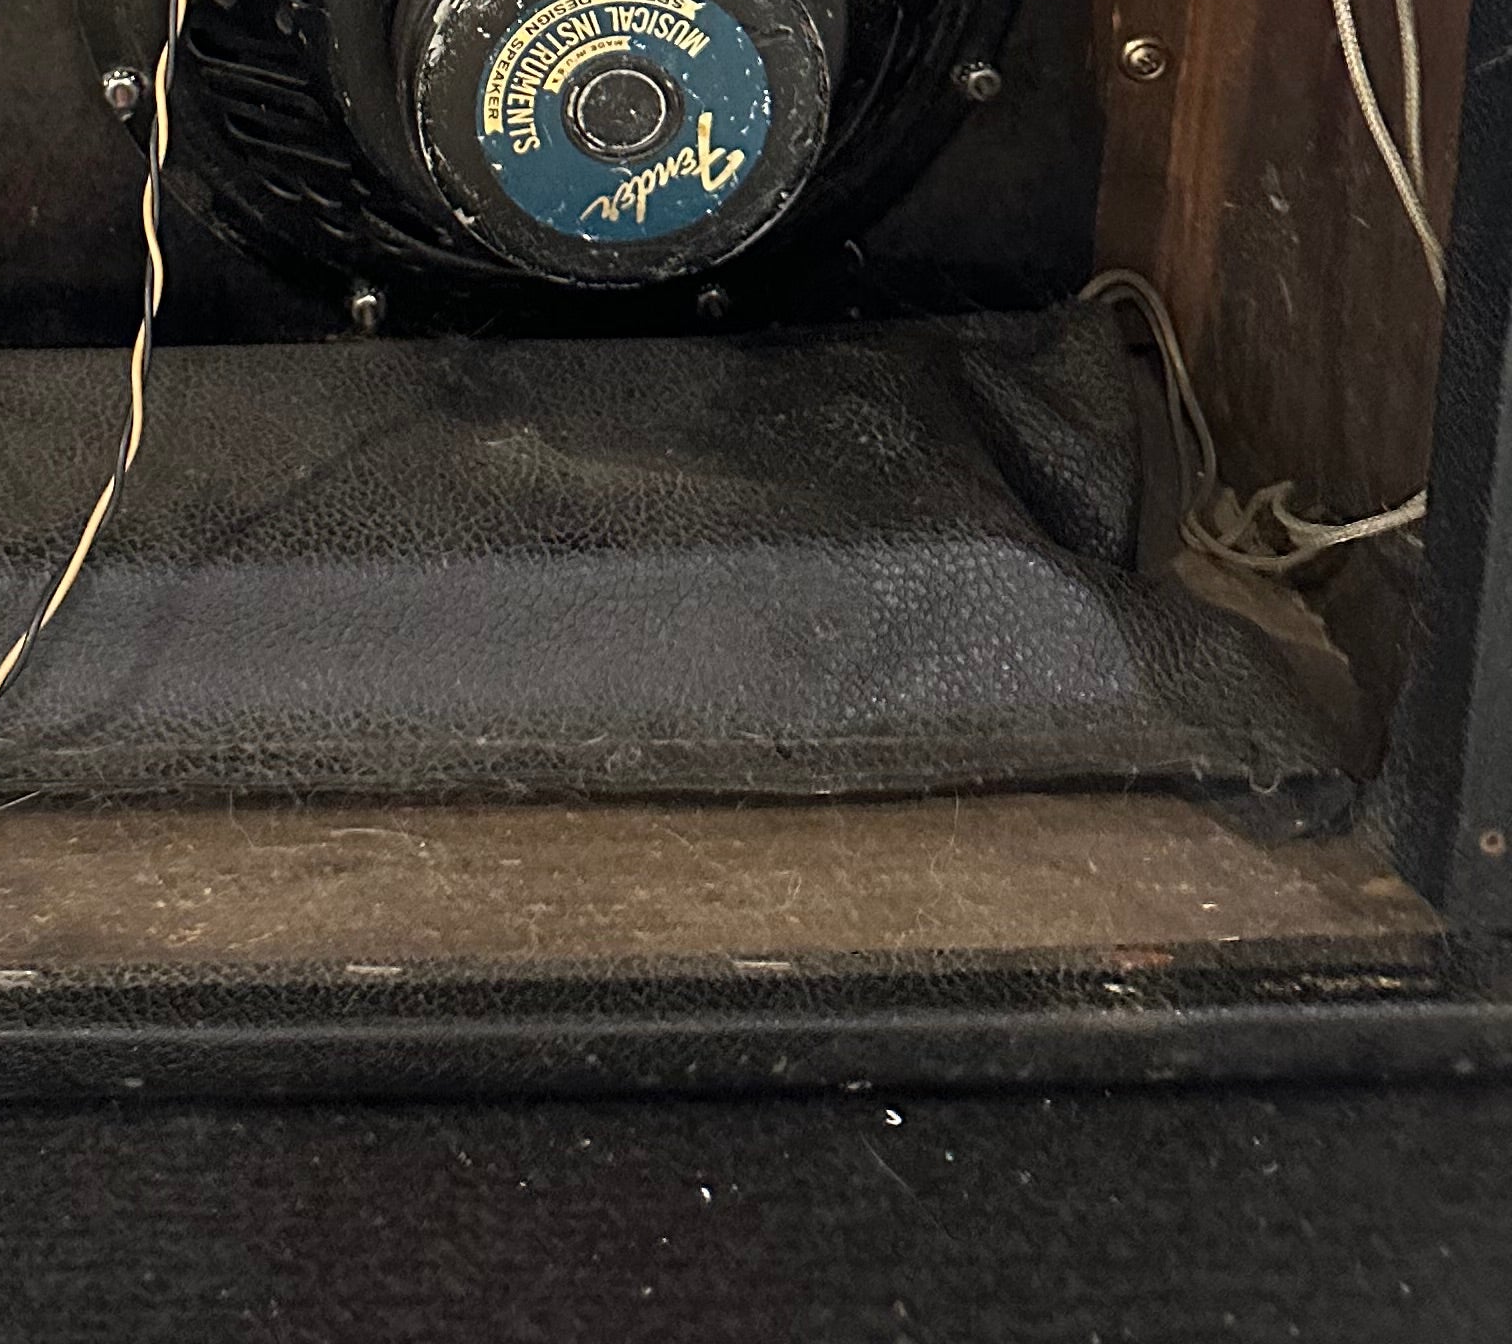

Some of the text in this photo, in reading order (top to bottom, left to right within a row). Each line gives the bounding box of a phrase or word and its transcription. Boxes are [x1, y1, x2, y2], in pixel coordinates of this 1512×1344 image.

[488, 37, 524, 120] SPEAKER
[506, 6, 710, 155] MUSICAL INSTRUMENTS
[576, 48, 588, 60] IN
[590, 39, 623, 53] MADE
[580, 112, 745, 224] Fender
